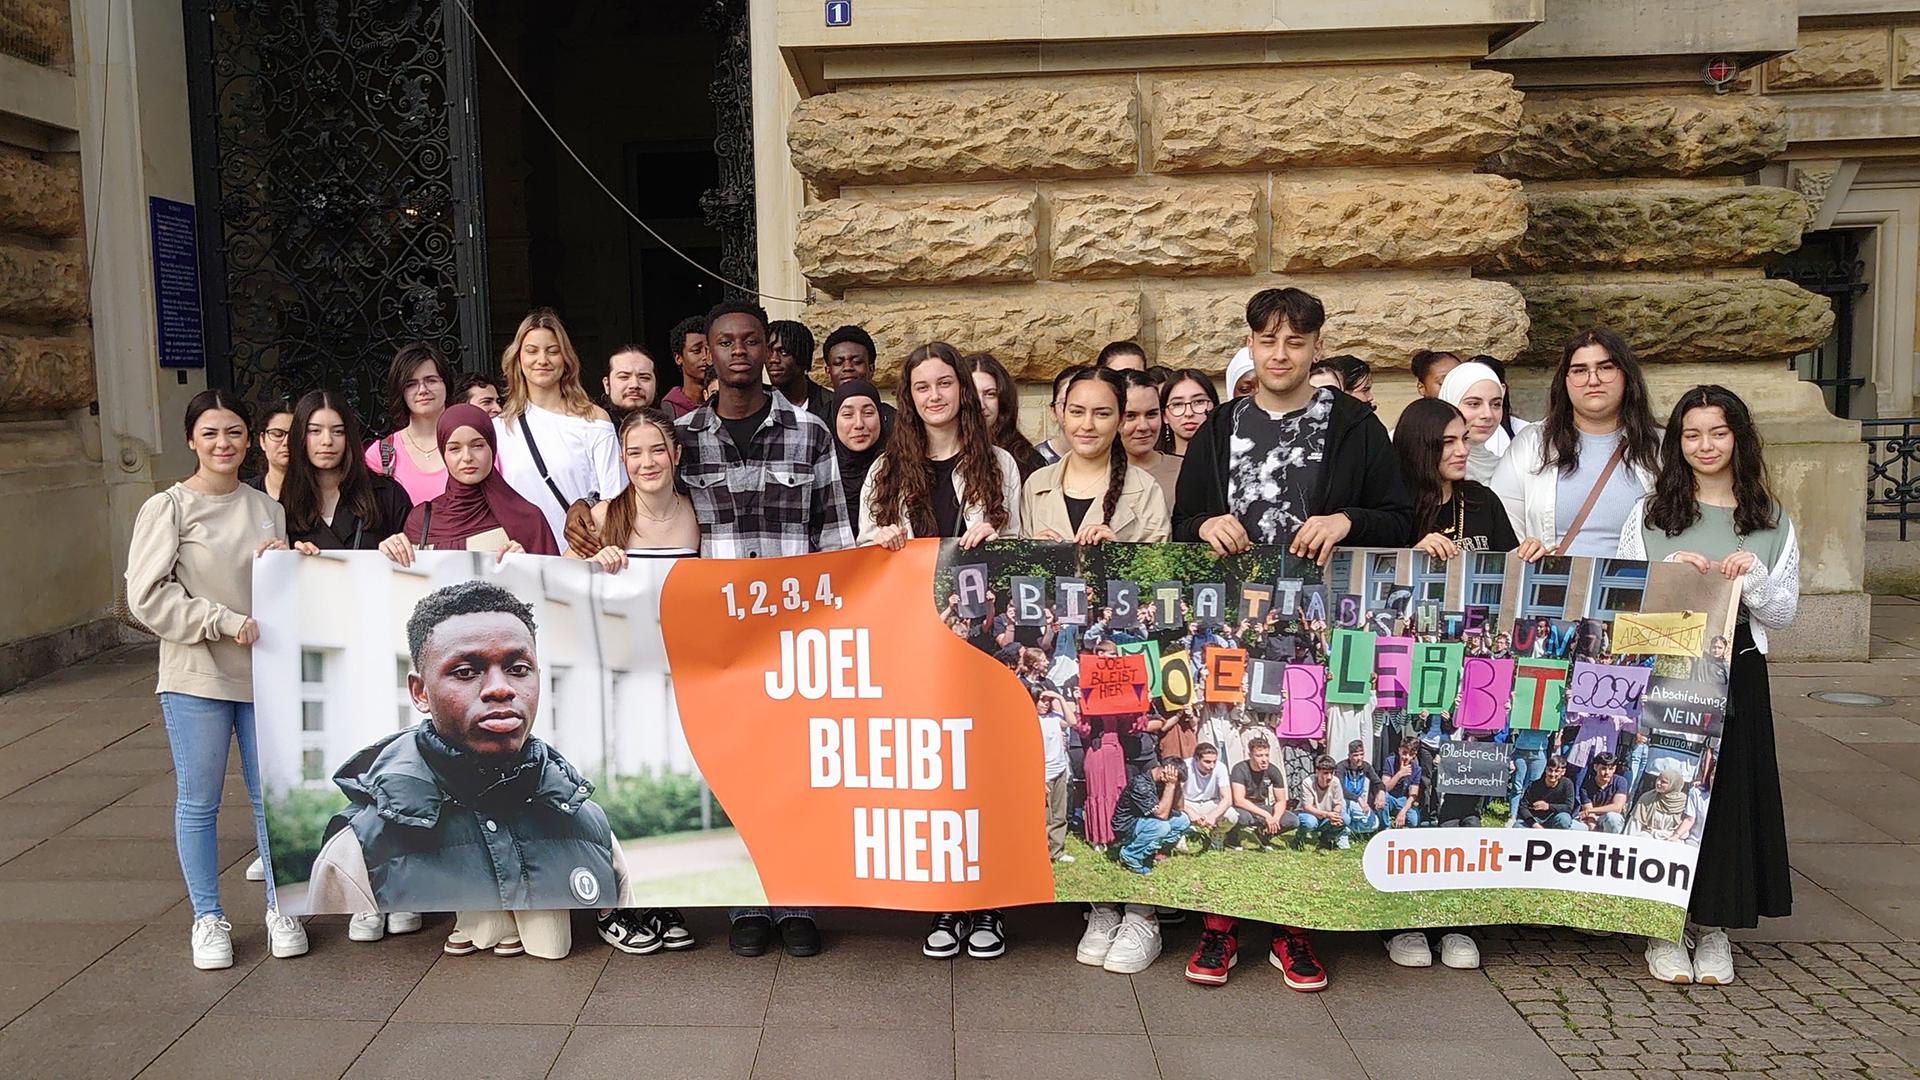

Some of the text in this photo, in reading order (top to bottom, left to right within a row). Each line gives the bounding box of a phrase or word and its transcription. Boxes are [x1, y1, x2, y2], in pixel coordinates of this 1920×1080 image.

[831, 3, 843, 23] 1
[764, 628, 882, 700] JOEL
[1096, 657, 1131, 670] JOEL
[1099, 683, 1124, 699] HIER
[1573, 671, 1645, 710] 2024
[1651, 685, 1727, 711] Abschiebung?
[809, 717, 973, 791] BLEIBT
[1440, 743, 1508, 764] Bleiberecht
[1457, 759, 1472, 773] ist
[1438, 771, 1505, 787] Menschenrecht
[852, 807, 980, 882] HIER!
